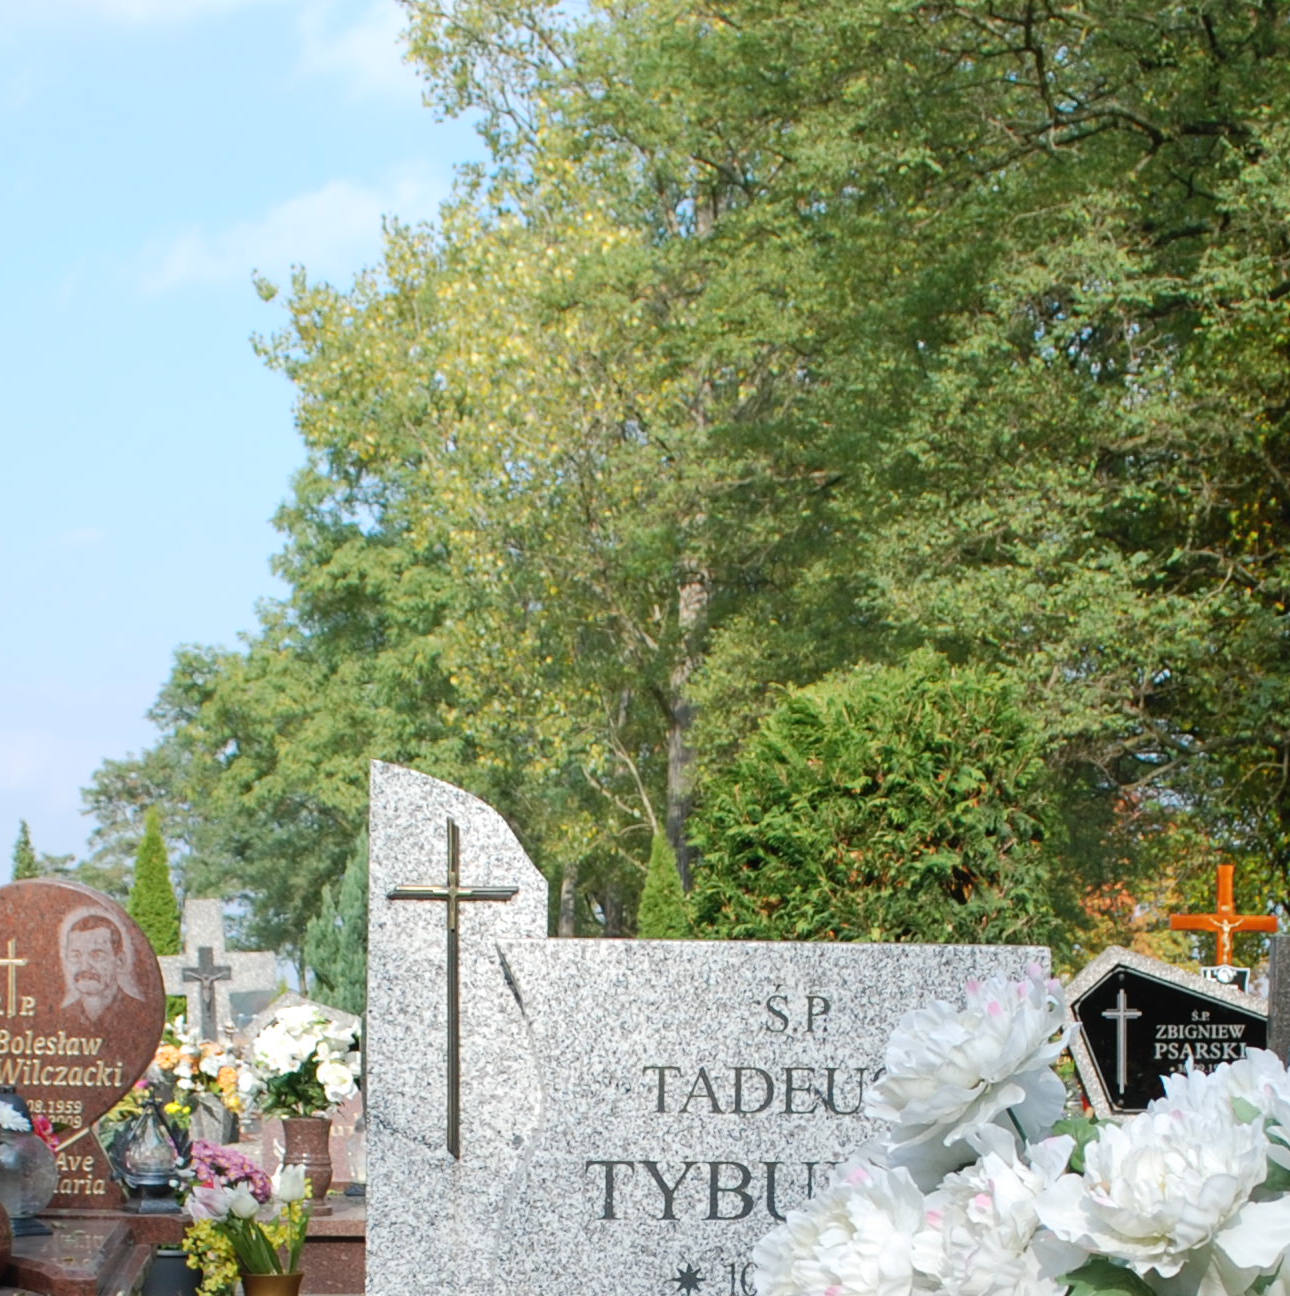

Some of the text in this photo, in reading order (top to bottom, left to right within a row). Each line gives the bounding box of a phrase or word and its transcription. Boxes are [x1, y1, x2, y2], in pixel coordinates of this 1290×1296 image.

[1155, 1024, 1246, 1040] ZBIGNIEW
[1154, 1042, 1247, 1060] PSARSKI
[642, 1065, 888, 1116] TADEU
[55, 1152, 95, 1171] Ave
[53, 1174, 107, 1195] aria
[584, 1160, 841, 1222] TYBU
